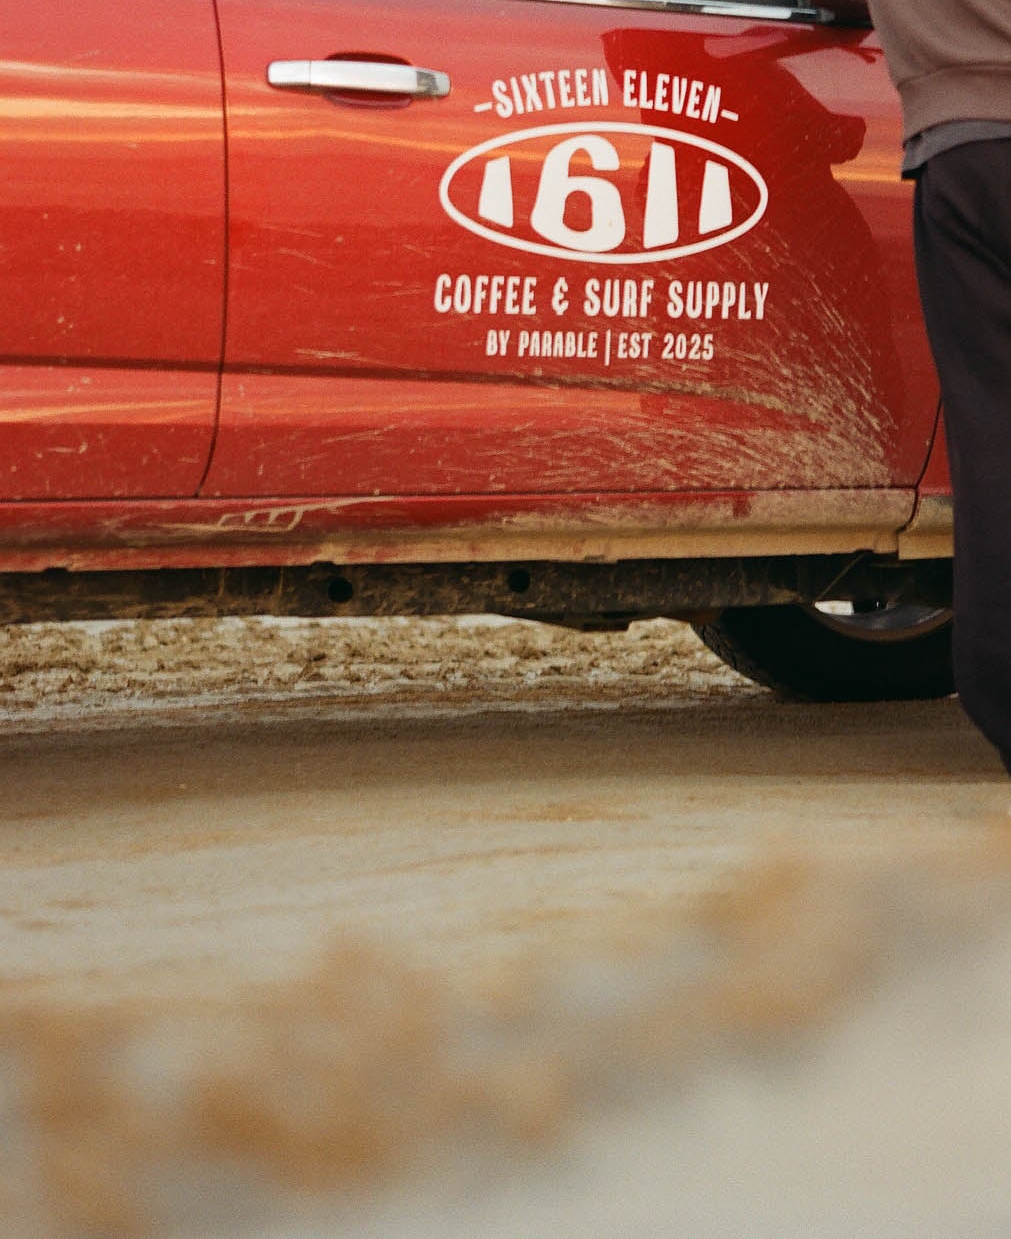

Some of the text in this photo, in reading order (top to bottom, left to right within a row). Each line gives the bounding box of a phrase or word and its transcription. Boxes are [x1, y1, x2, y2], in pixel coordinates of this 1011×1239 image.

[478, 135, 733, 253] 1611
[434, 274, 769, 321] COFFEE & SURF SUPPLY
[486, 329, 511, 357] BY
[517, 330, 598, 359] PARABLE
[617, 332, 652, 360] EST
[661, 332, 714, 361] 2025
